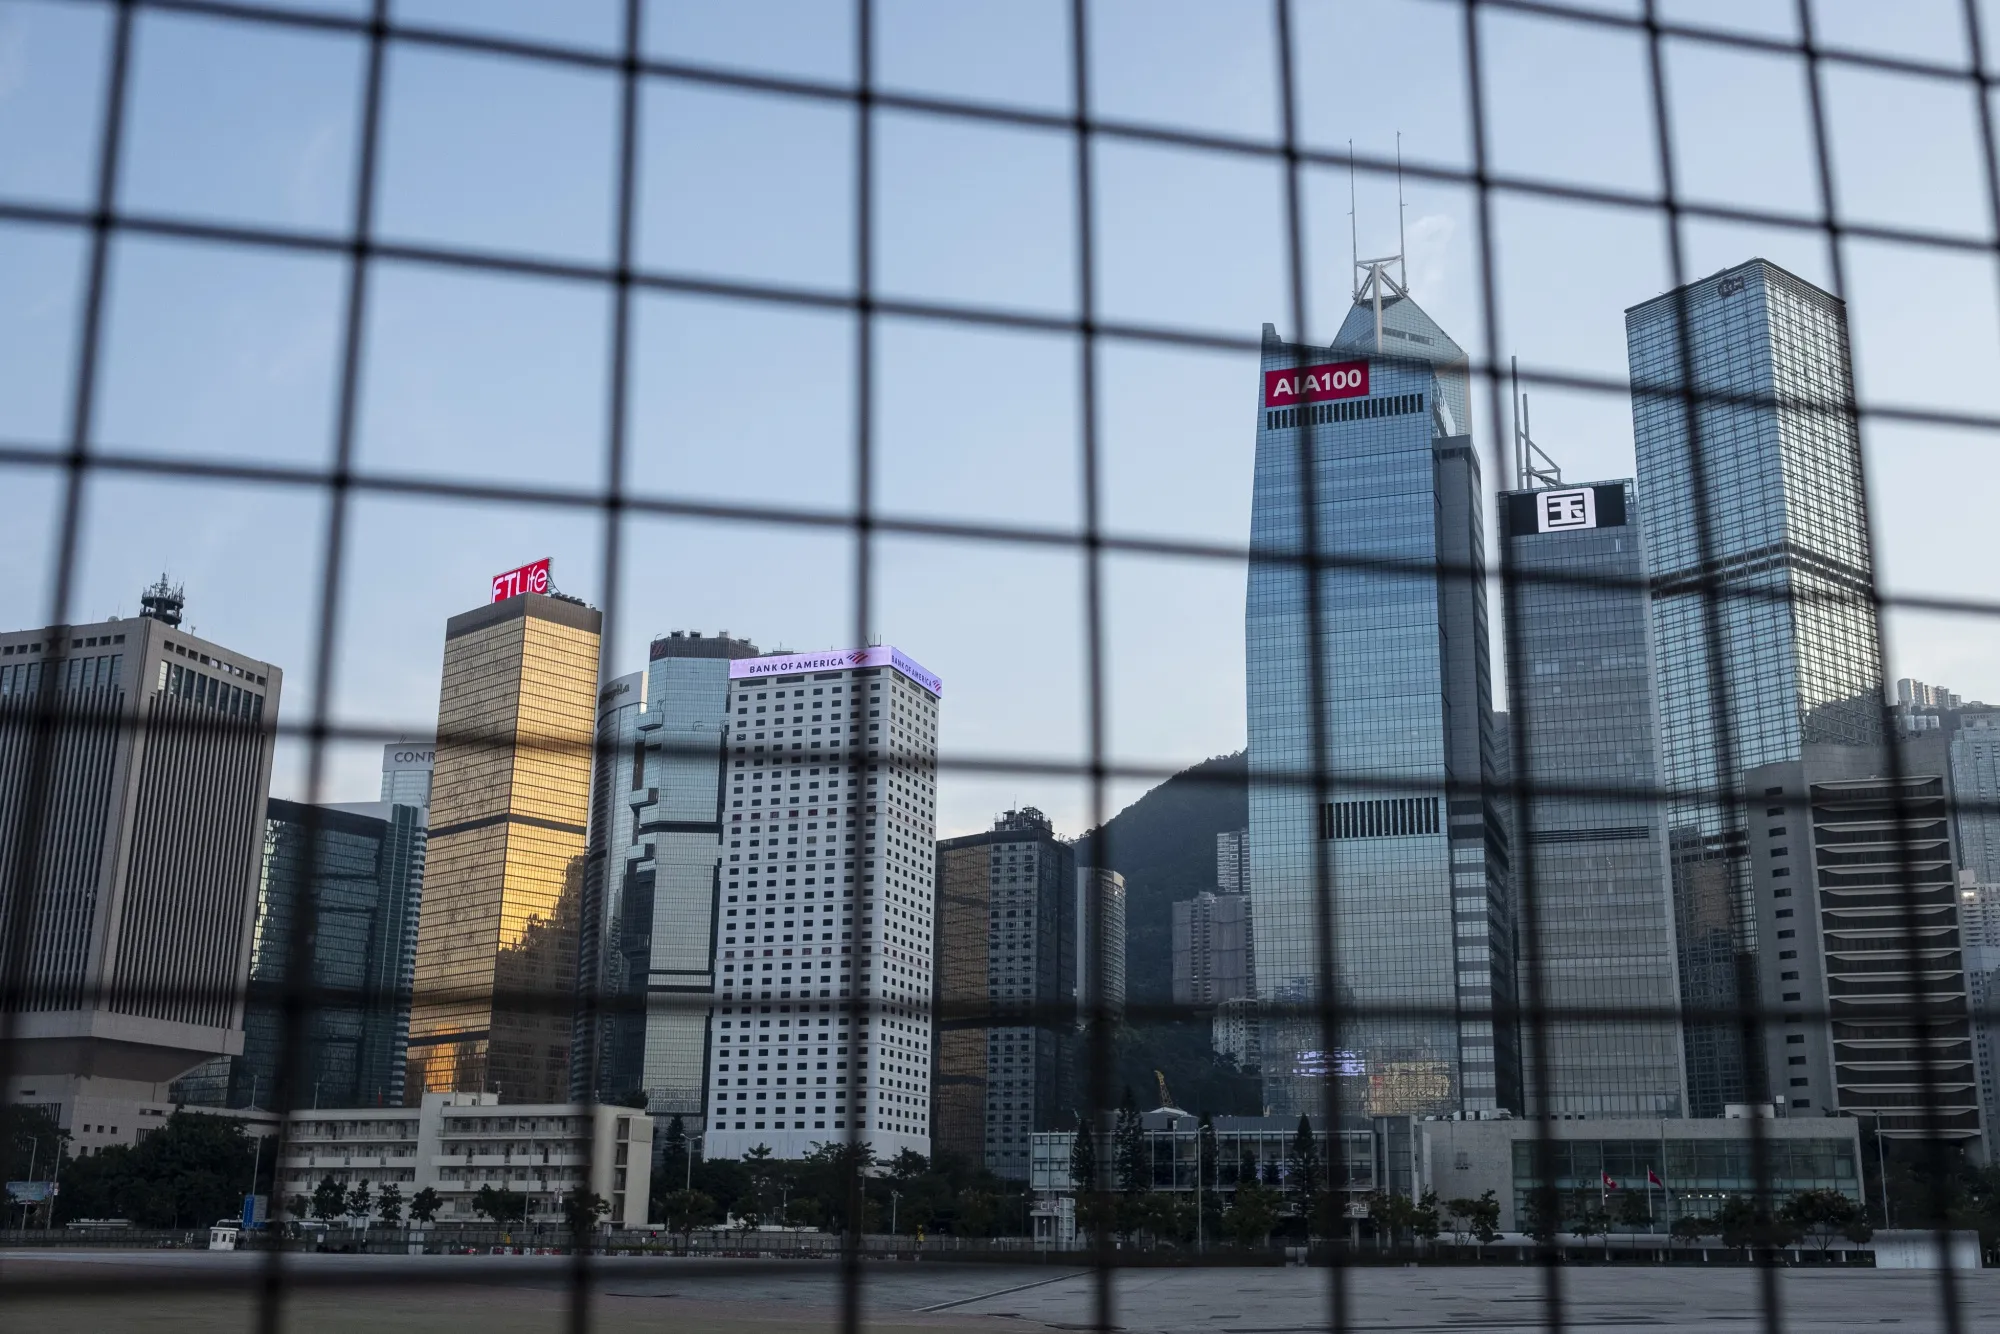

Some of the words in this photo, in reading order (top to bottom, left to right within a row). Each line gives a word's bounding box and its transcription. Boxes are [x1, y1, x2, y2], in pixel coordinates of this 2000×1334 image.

[1273, 369, 1362, 397] AIA100
[492, 564, 547, 604] FTLife
[749, 663, 778, 674] BANK
[780, 662, 794, 671] OF
[795, 658, 844, 670] AMERICA
[891, 654, 905, 670] BANK
[905, 664, 912, 674] OF
[912, 668, 932, 687] AMERICA
